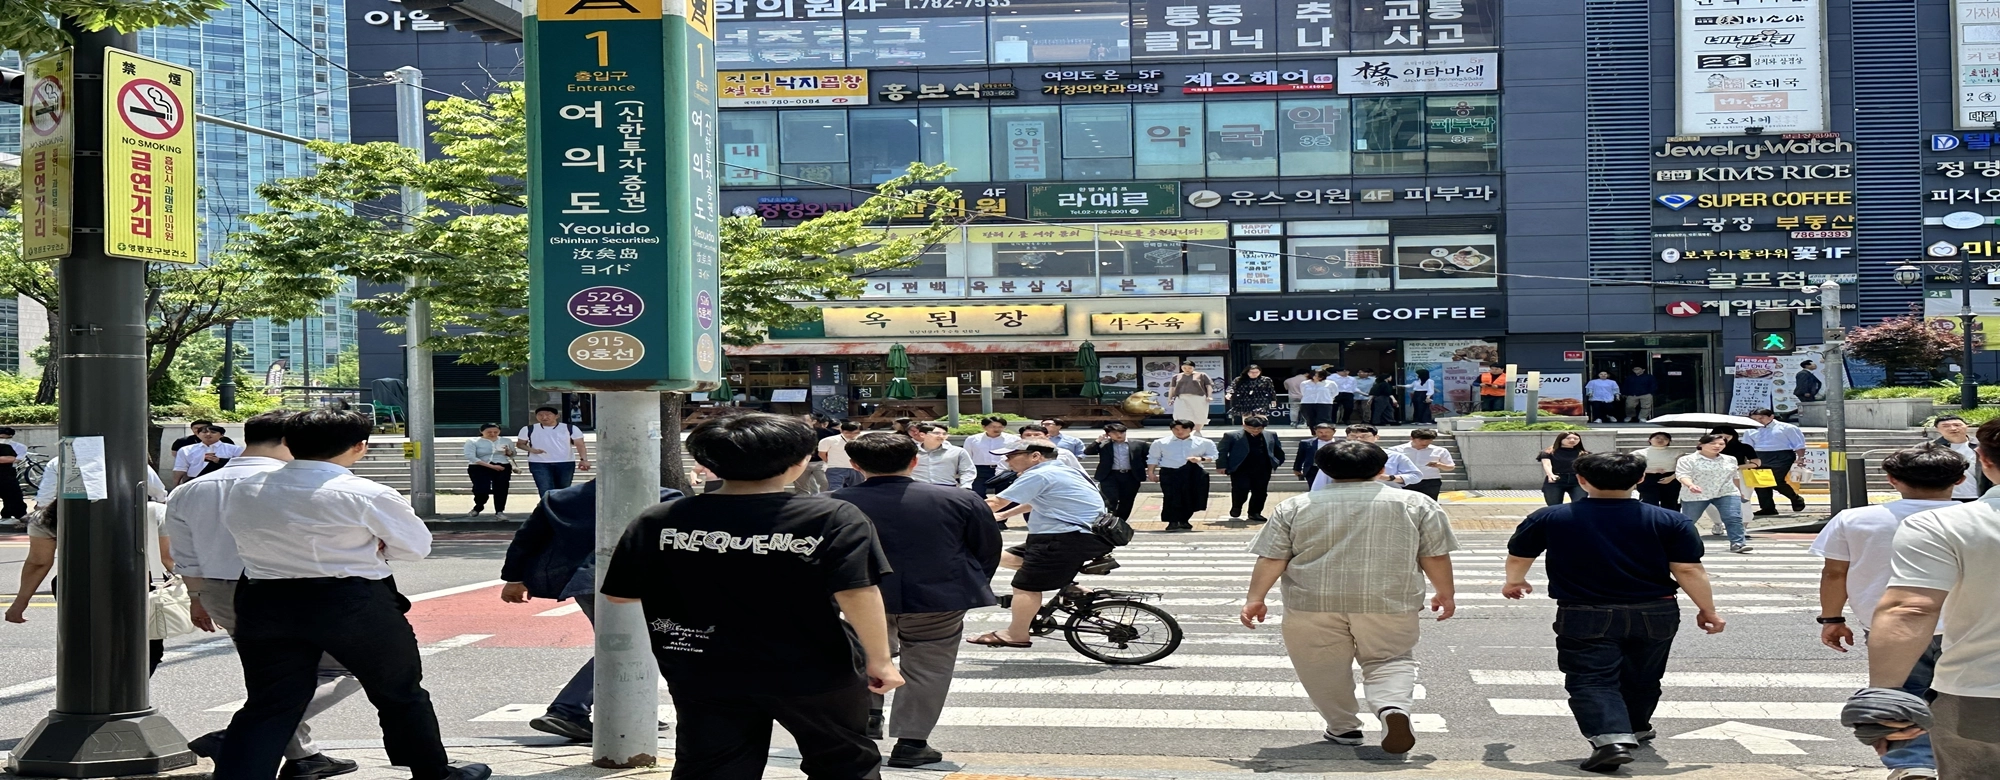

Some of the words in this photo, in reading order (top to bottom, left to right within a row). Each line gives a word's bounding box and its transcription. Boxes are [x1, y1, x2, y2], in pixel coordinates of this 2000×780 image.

[1164, 4, 1242, 26] 통증
[1296, 0, 1332, 24] 추
[1383, 0, 1464, 22] 교통
[1144, 29, 1264, 51] 클리닉
[1297, 27, 1334, 48] 나
[1384, 24, 1465, 46] 사고
[585, 30, 608, 66] 1
[697, 41, 704, 78] 1
[122, 61, 136, 76] 禁
[168, 72, 182, 88] 煙
[575, 70, 628, 82] 출입구
[1044, 70, 1096, 82] 여의도
[1102, 70, 1120, 80] 온
[1138, 70, 1161, 79] 5F
[1184, 69, 1309, 87] 제오헤어
[1403, 64, 1484, 78] 이타마에
[567, 84, 636, 92] Entrance
[775, 76, 863, 90] 낙지곱창
[1044, 83, 1159, 96] 가정의학과의원
[1747, 78, 1799, 88] 순대국
[880, 82, 980, 102] 홍보석
[1288, 106, 1342, 136] 약
[1431, 117, 1496, 134] 피부과
[122, 136, 136, 146] NO
[137, 139, 182, 155] SMOKING
[1655, 140, 1760, 160] Jewelry
[1764, 137, 1852, 154] Watch
[559, 101, 610, 214] 여의도
[615, 100, 647, 214] (신한투자증권)
[732, 144, 762, 180] 내과
[1012, 138, 1040, 172] 약국
[164, 156, 174, 185] 흡연시
[1696, 166, 1774, 182] KIM'S
[1780, 164, 1852, 180] RICE
[34, 150, 46, 238] 금연거리
[130, 150, 152, 239] 금연거리
[164, 186, 174, 214] 과태료
[982, 188, 1006, 197] 4F
[1058, 192, 1149, 208] 라메르
[1228, 190, 1286, 206] 유스
[1294, 188, 1350, 204] 의원
[1363, 190, 1391, 200] 4F
[1403, 185, 1494, 202] 피부과
[1698, 192, 1767, 208] SUPER
[1772, 190, 1852, 206] COFFEE
[164, 215, 174, 241] 10만원
[559, 222, 650, 234] Yeouido
[1776, 215, 1855, 230] 부동산
[550, 236, 598, 244] (Shinhan
[602, 236, 660, 244] Securities)
[128, 243, 188, 258] 영등포구보건소
[573, 248, 639, 260] 汝矣岛
[1683, 248, 1788, 261] 보투아플라워
[1792, 246, 1820, 261] 꽃
[1822, 246, 1852, 259] 1F
[581, 264, 632, 275] ヨイド
[874, 281, 946, 294] 이편백
[971, 279, 1072, 294] 육분삼십
[1120, 278, 1175, 292] 본점
[1708, 271, 1806, 289] 골프점
[587, 292, 624, 302] 526
[576, 304, 634, 317] 5호선
[859, 309, 1028, 329] 옥된장
[1248, 309, 1359, 322] JEJUICE
[1372, 306, 1486, 321] COFFEE
[588, 336, 624, 347] 915
[576, 349, 634, 361] 9호선
[961, 371, 1016, 382] 막리
[962, 386, 1012, 397] 소주
[660, 528, 824, 555] FREQUENCY
[662, 645, 704, 653] conservation
